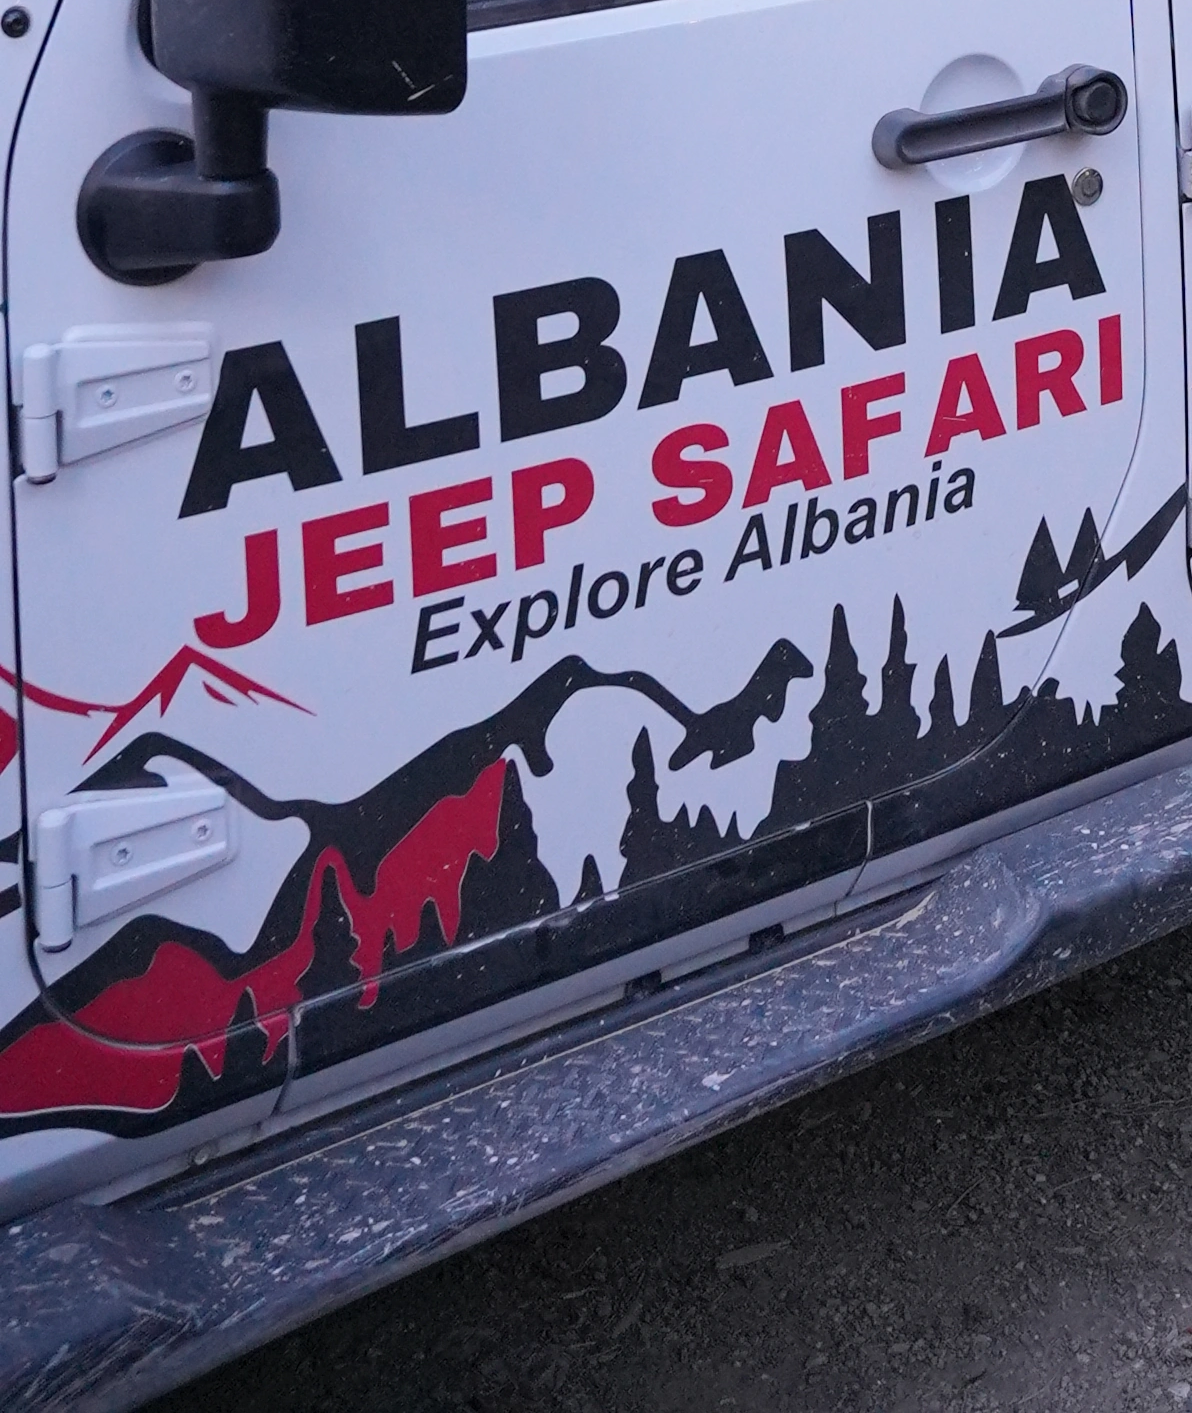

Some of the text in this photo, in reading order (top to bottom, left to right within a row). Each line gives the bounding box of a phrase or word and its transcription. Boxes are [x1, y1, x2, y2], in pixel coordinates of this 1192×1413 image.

[178, 173, 1107, 519] ALBANIA
[194, 314, 1124, 648] JEEP SAFARI
[411, 460, 976, 673] Explore Albania
